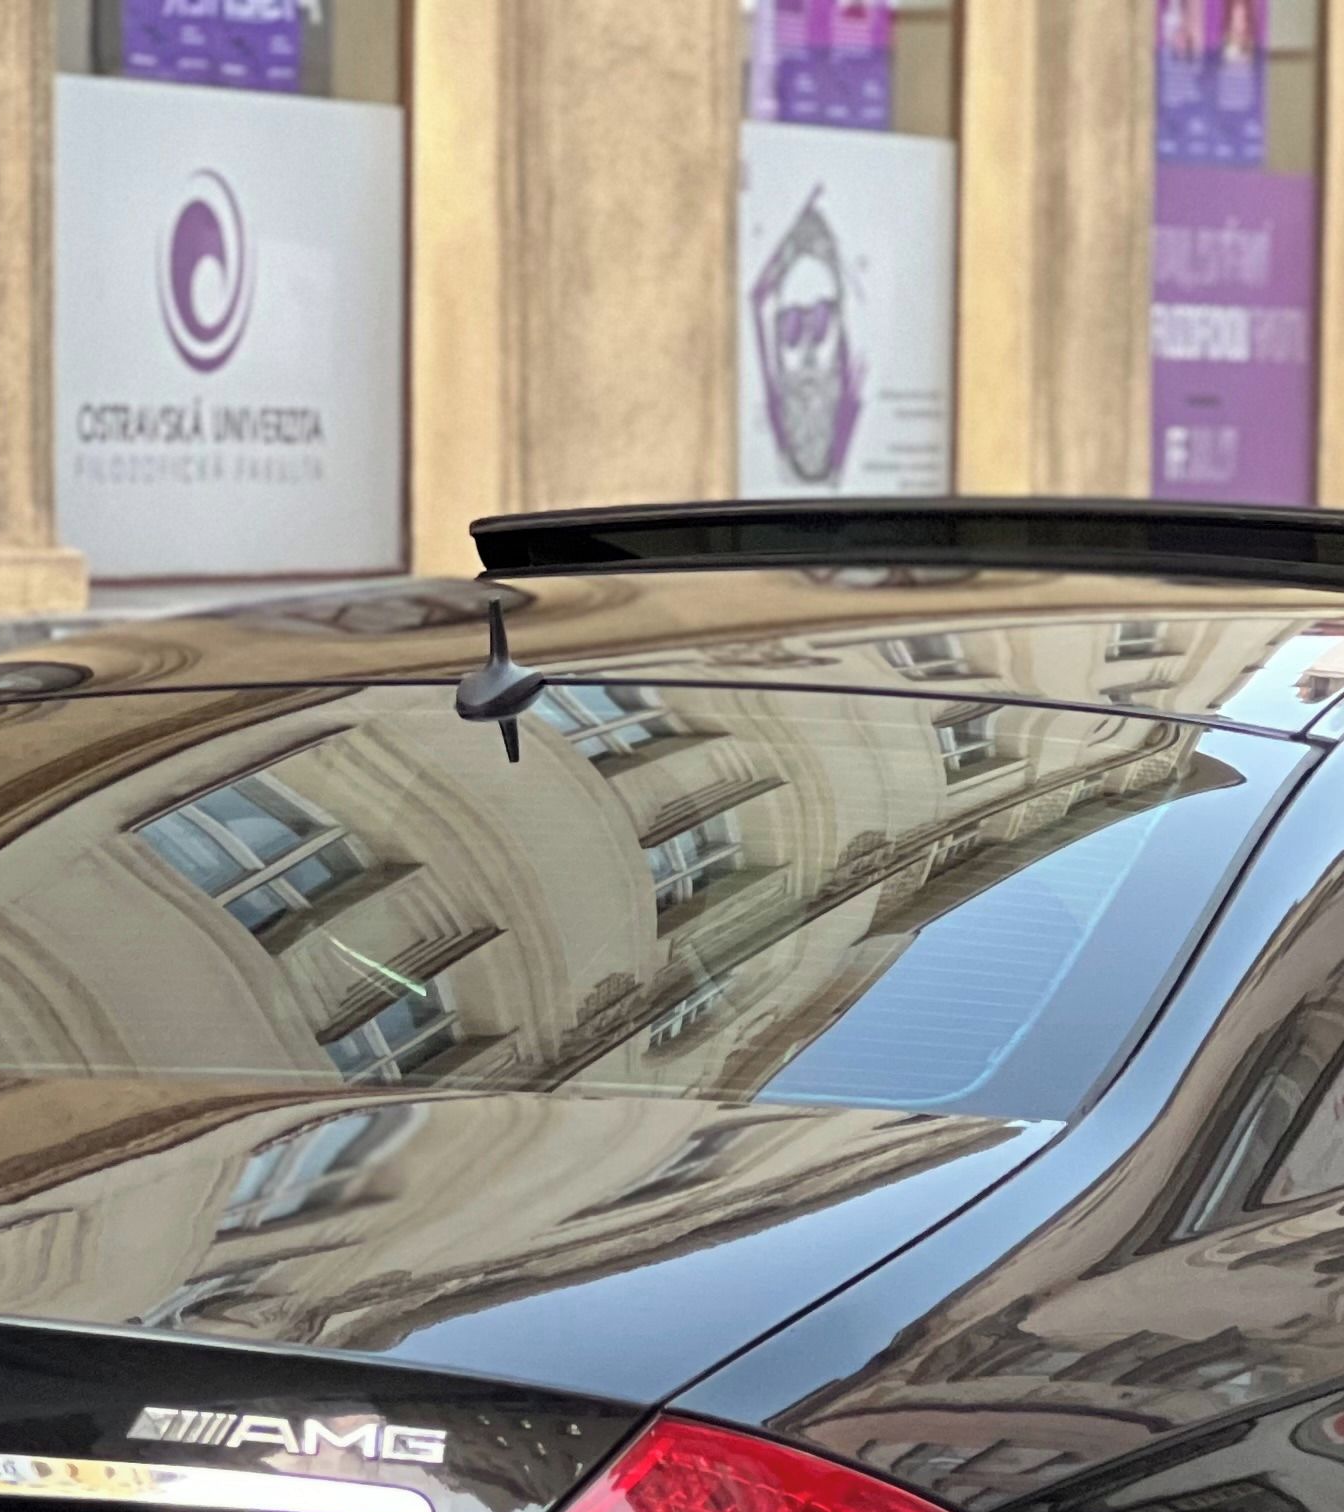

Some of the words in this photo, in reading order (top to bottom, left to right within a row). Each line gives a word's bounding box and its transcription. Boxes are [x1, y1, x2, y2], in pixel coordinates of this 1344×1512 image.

[77, 396, 205, 444] OSTRAVSKÁ
[213, 404, 324, 446] UNIVERZITA
[226, 1414, 447, 1464] AMG
